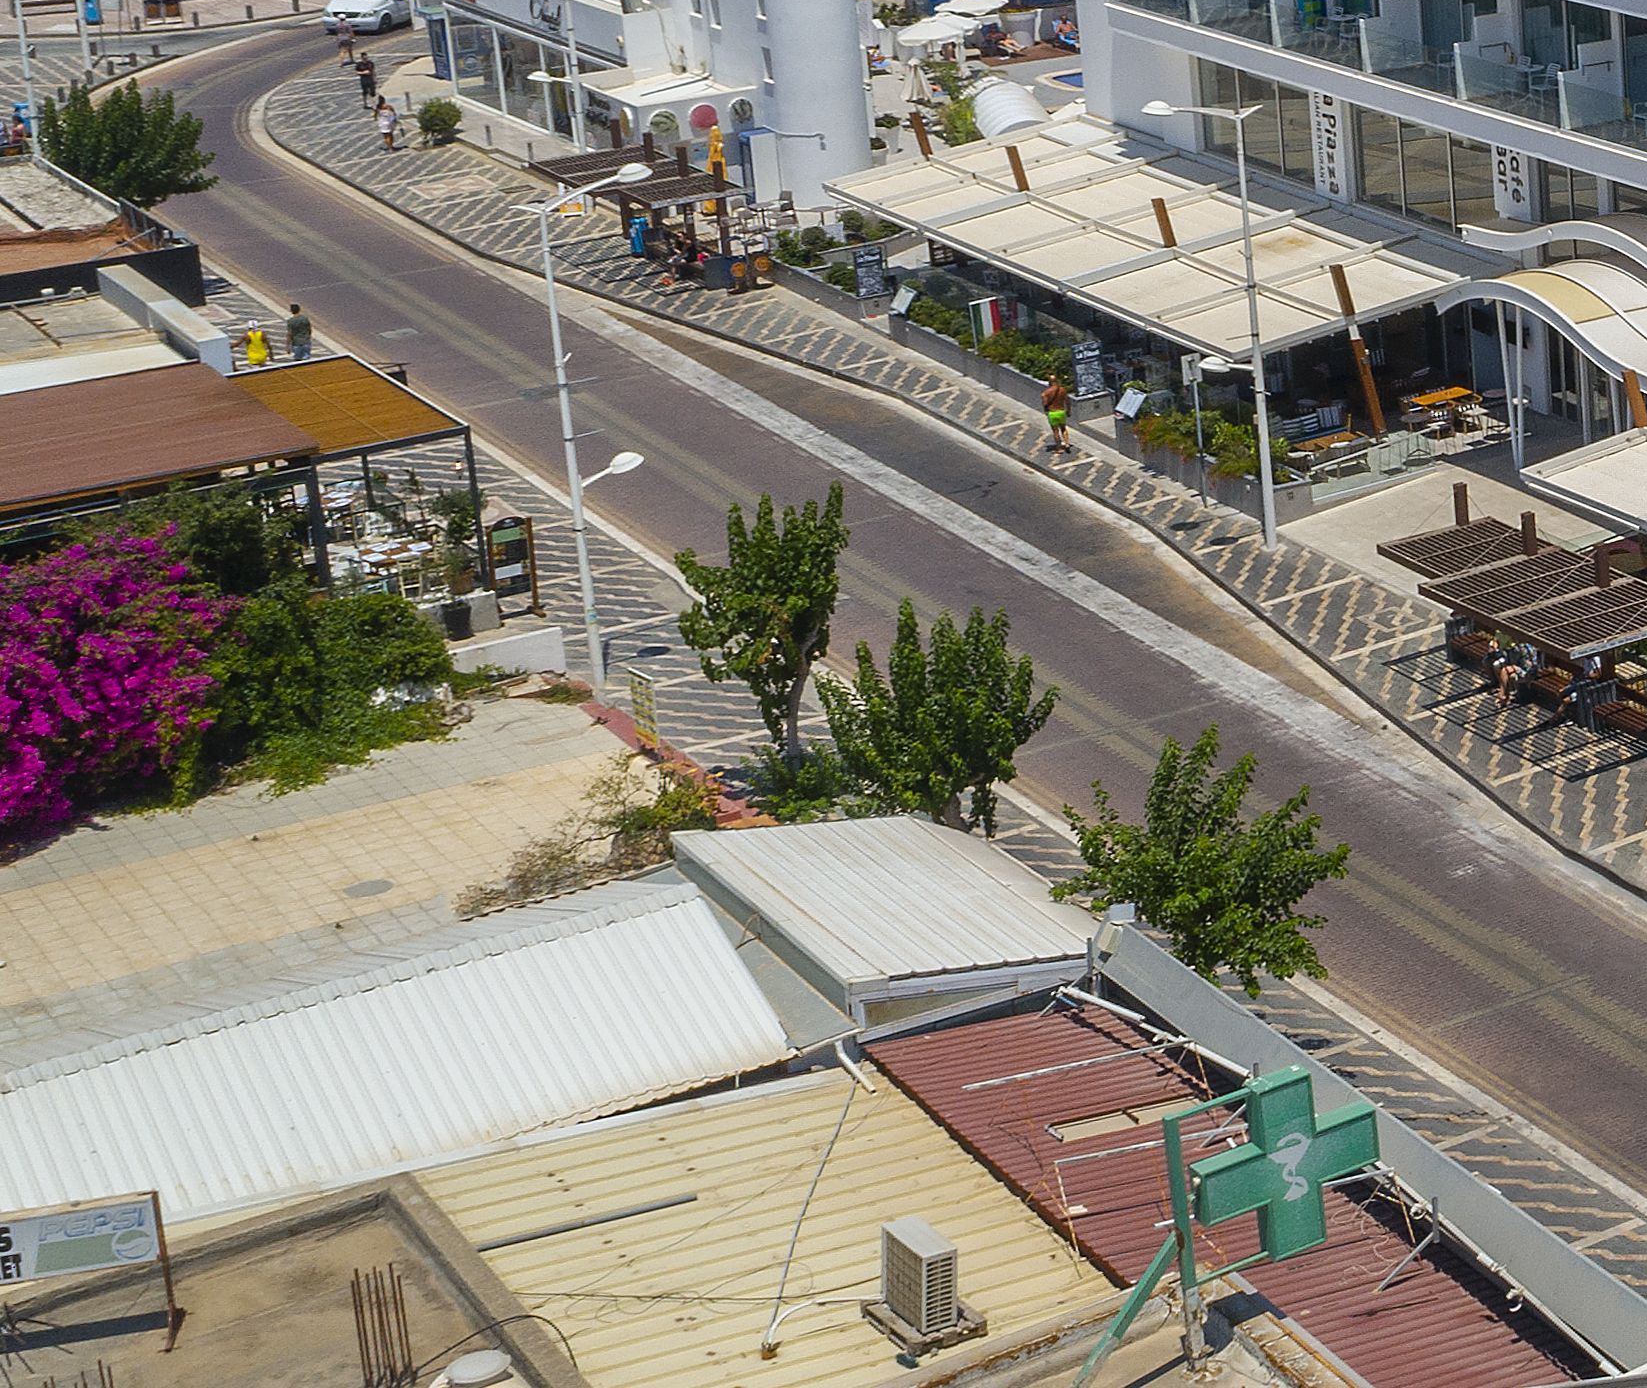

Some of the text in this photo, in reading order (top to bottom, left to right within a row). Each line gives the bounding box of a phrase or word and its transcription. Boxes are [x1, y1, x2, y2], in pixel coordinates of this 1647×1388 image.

[1322, 113, 1339, 194] Piazza
[1509, 150, 1526, 204] afé
[38, 1207, 145, 1241] PEPSI
